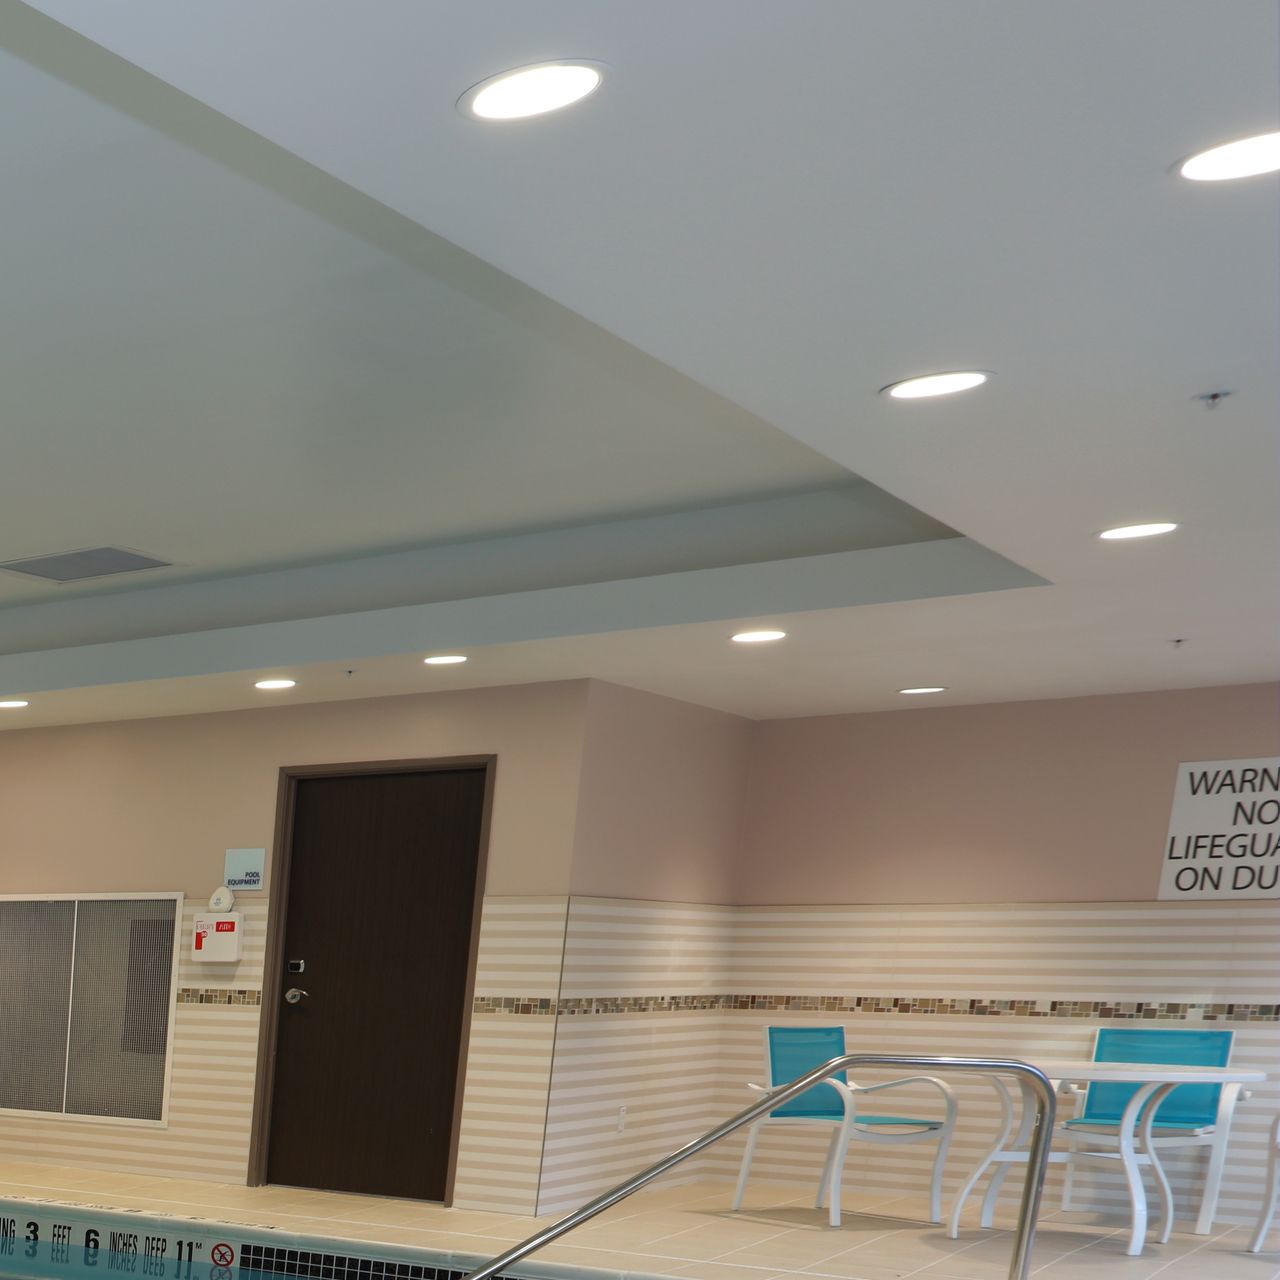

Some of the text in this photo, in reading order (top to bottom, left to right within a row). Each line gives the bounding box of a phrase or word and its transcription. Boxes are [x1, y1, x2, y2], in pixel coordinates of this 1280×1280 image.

[1232, 800, 1280, 825] NO
[227, 878, 260, 886] EQUIPMENT
[1175, 866, 1223, 891] ON
[25, 1221, 40, 1242] 3
[52, 1224, 72, 1245] FEET
[84, 1229, 100, 1249] 6
[109, 1231, 138, 1255] INCHES
[143, 1236, 167, 1259] DEEP
